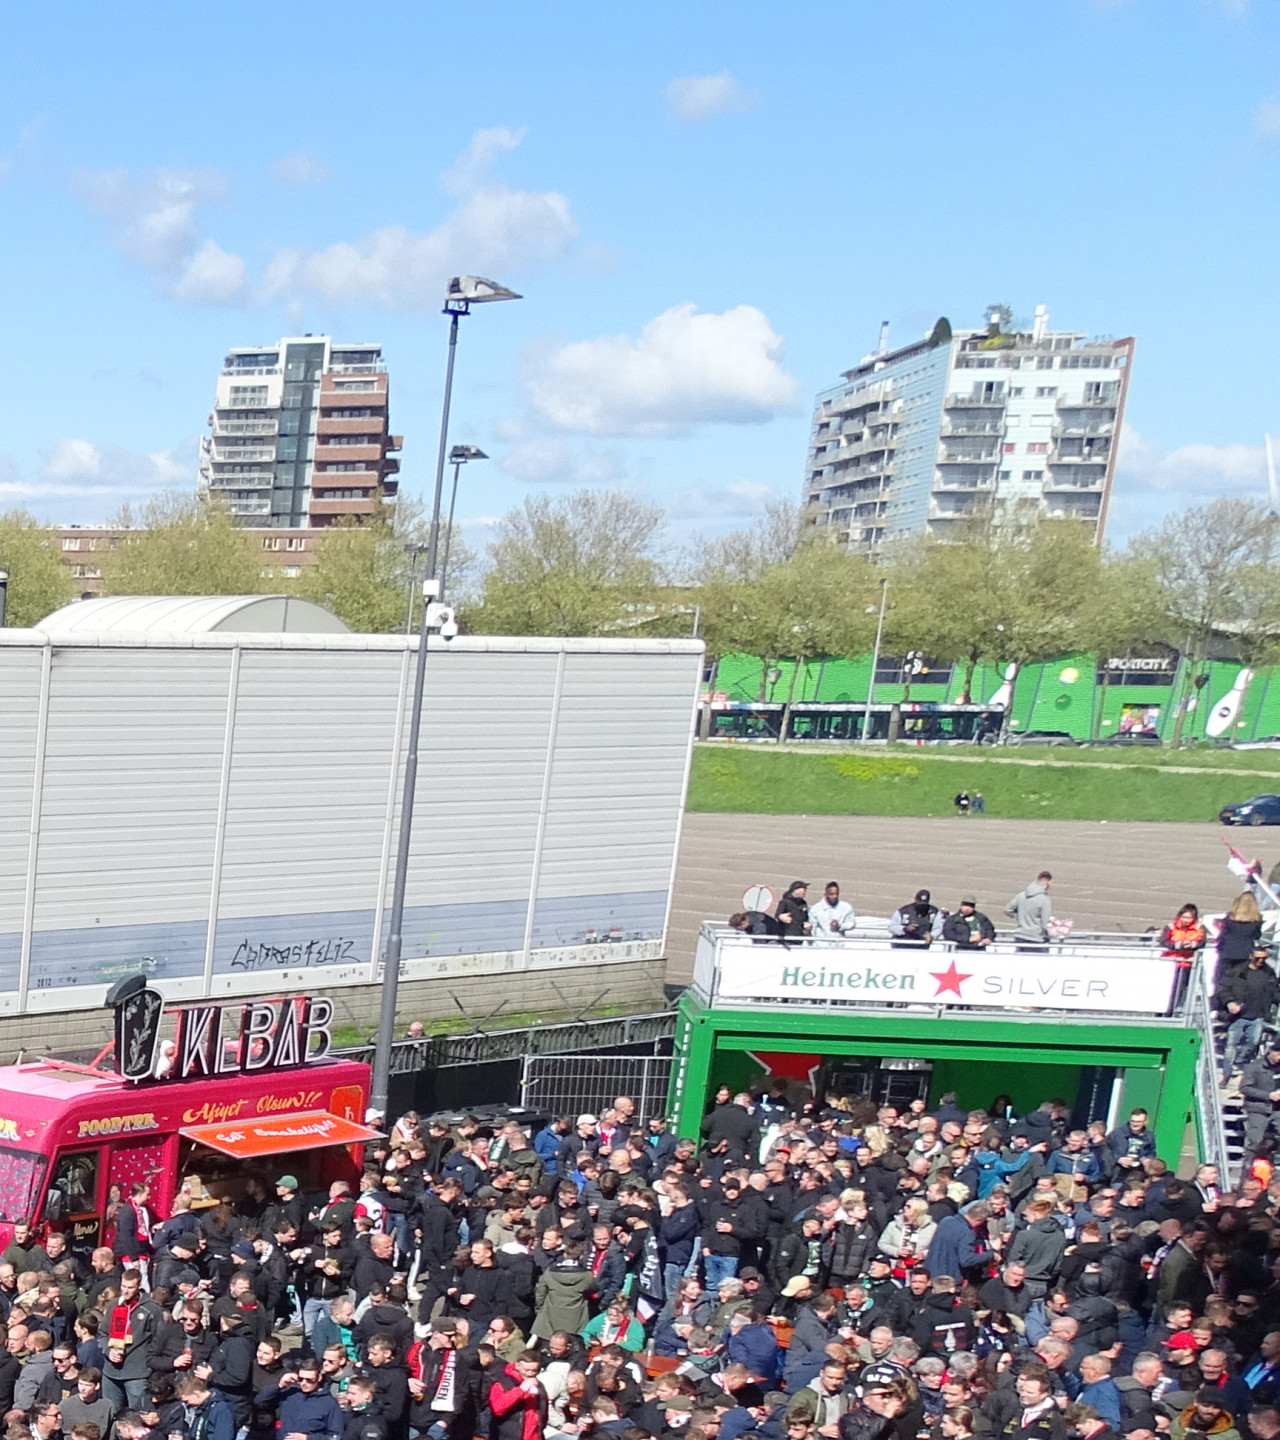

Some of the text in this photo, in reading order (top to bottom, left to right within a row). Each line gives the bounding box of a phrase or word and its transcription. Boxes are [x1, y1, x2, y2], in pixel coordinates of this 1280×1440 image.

[779, 966, 1109, 998] Heineken SILVER
[181, 996, 335, 1078] KEBAB
[77, 1112, 160, 1138] FOODTRK
